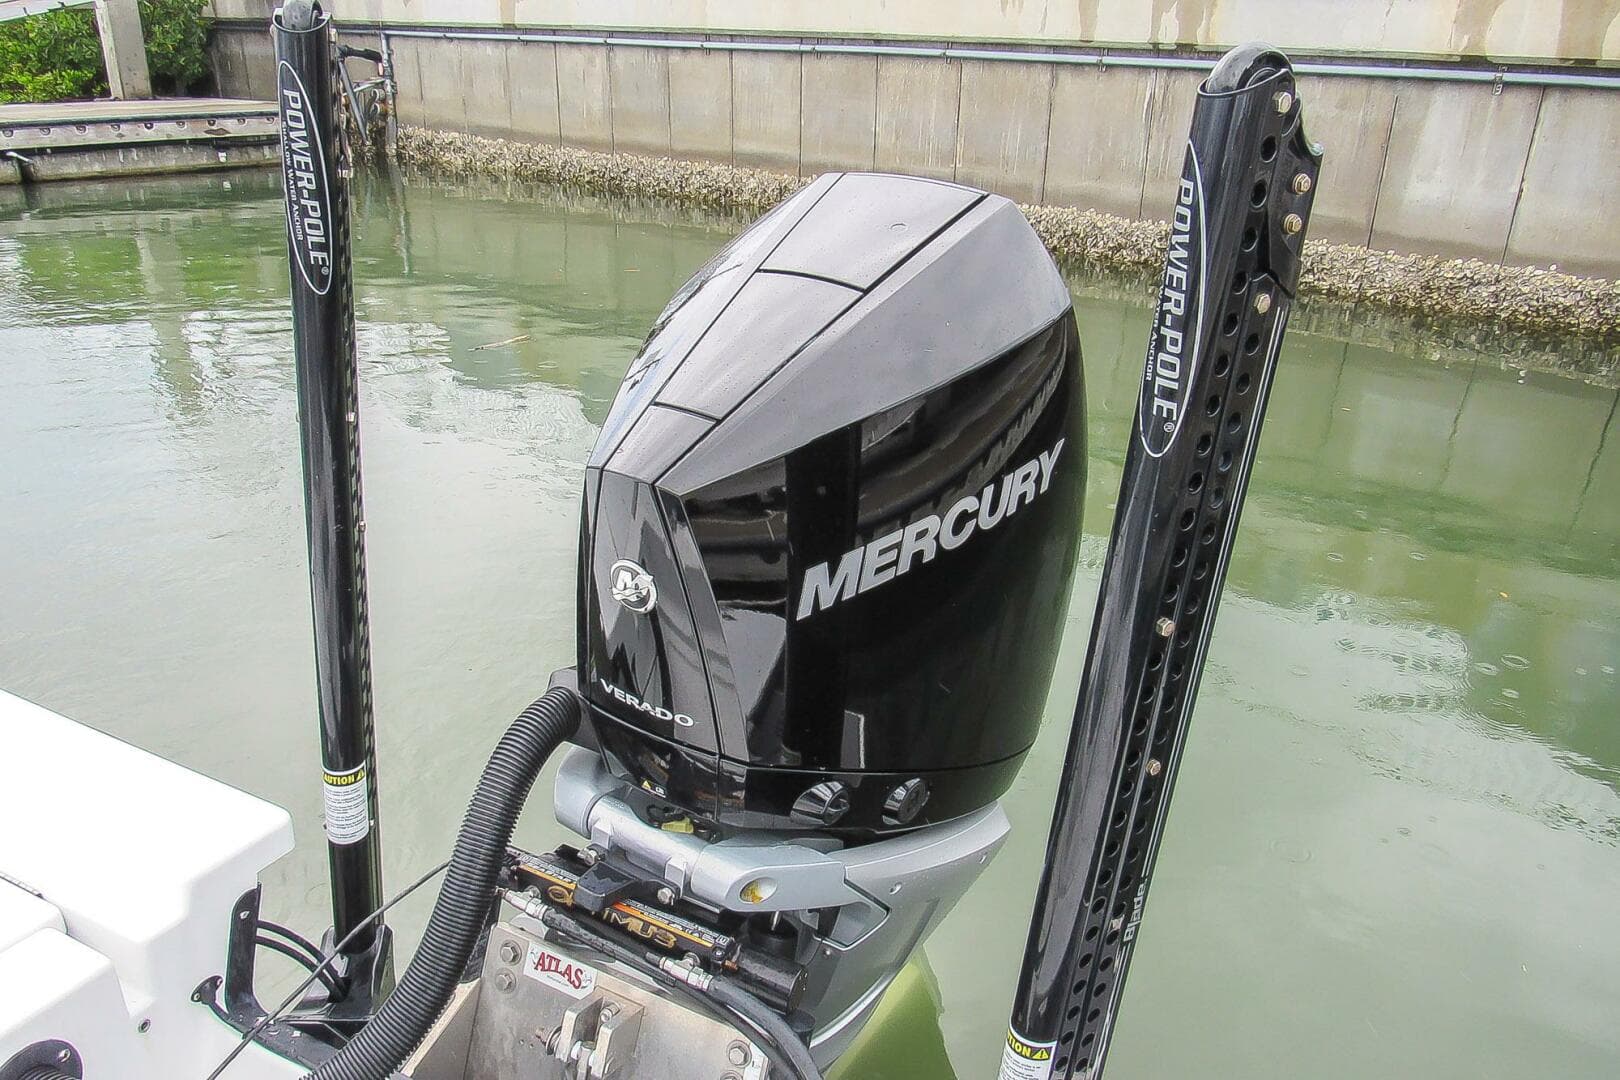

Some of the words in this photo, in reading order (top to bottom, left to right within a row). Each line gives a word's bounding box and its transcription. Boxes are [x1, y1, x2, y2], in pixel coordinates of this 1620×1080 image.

[287, 169, 297, 201] WATER
[291, 203, 304, 241] ANCHOR
[1145, 331, 1158, 381] ANCHOR
[796, 438, 1065, 622] MERCURY
[600, 678, 694, 727] VERADO
[322, 770, 356, 785] AUTION
[533, 951, 584, 990] ATLAS
